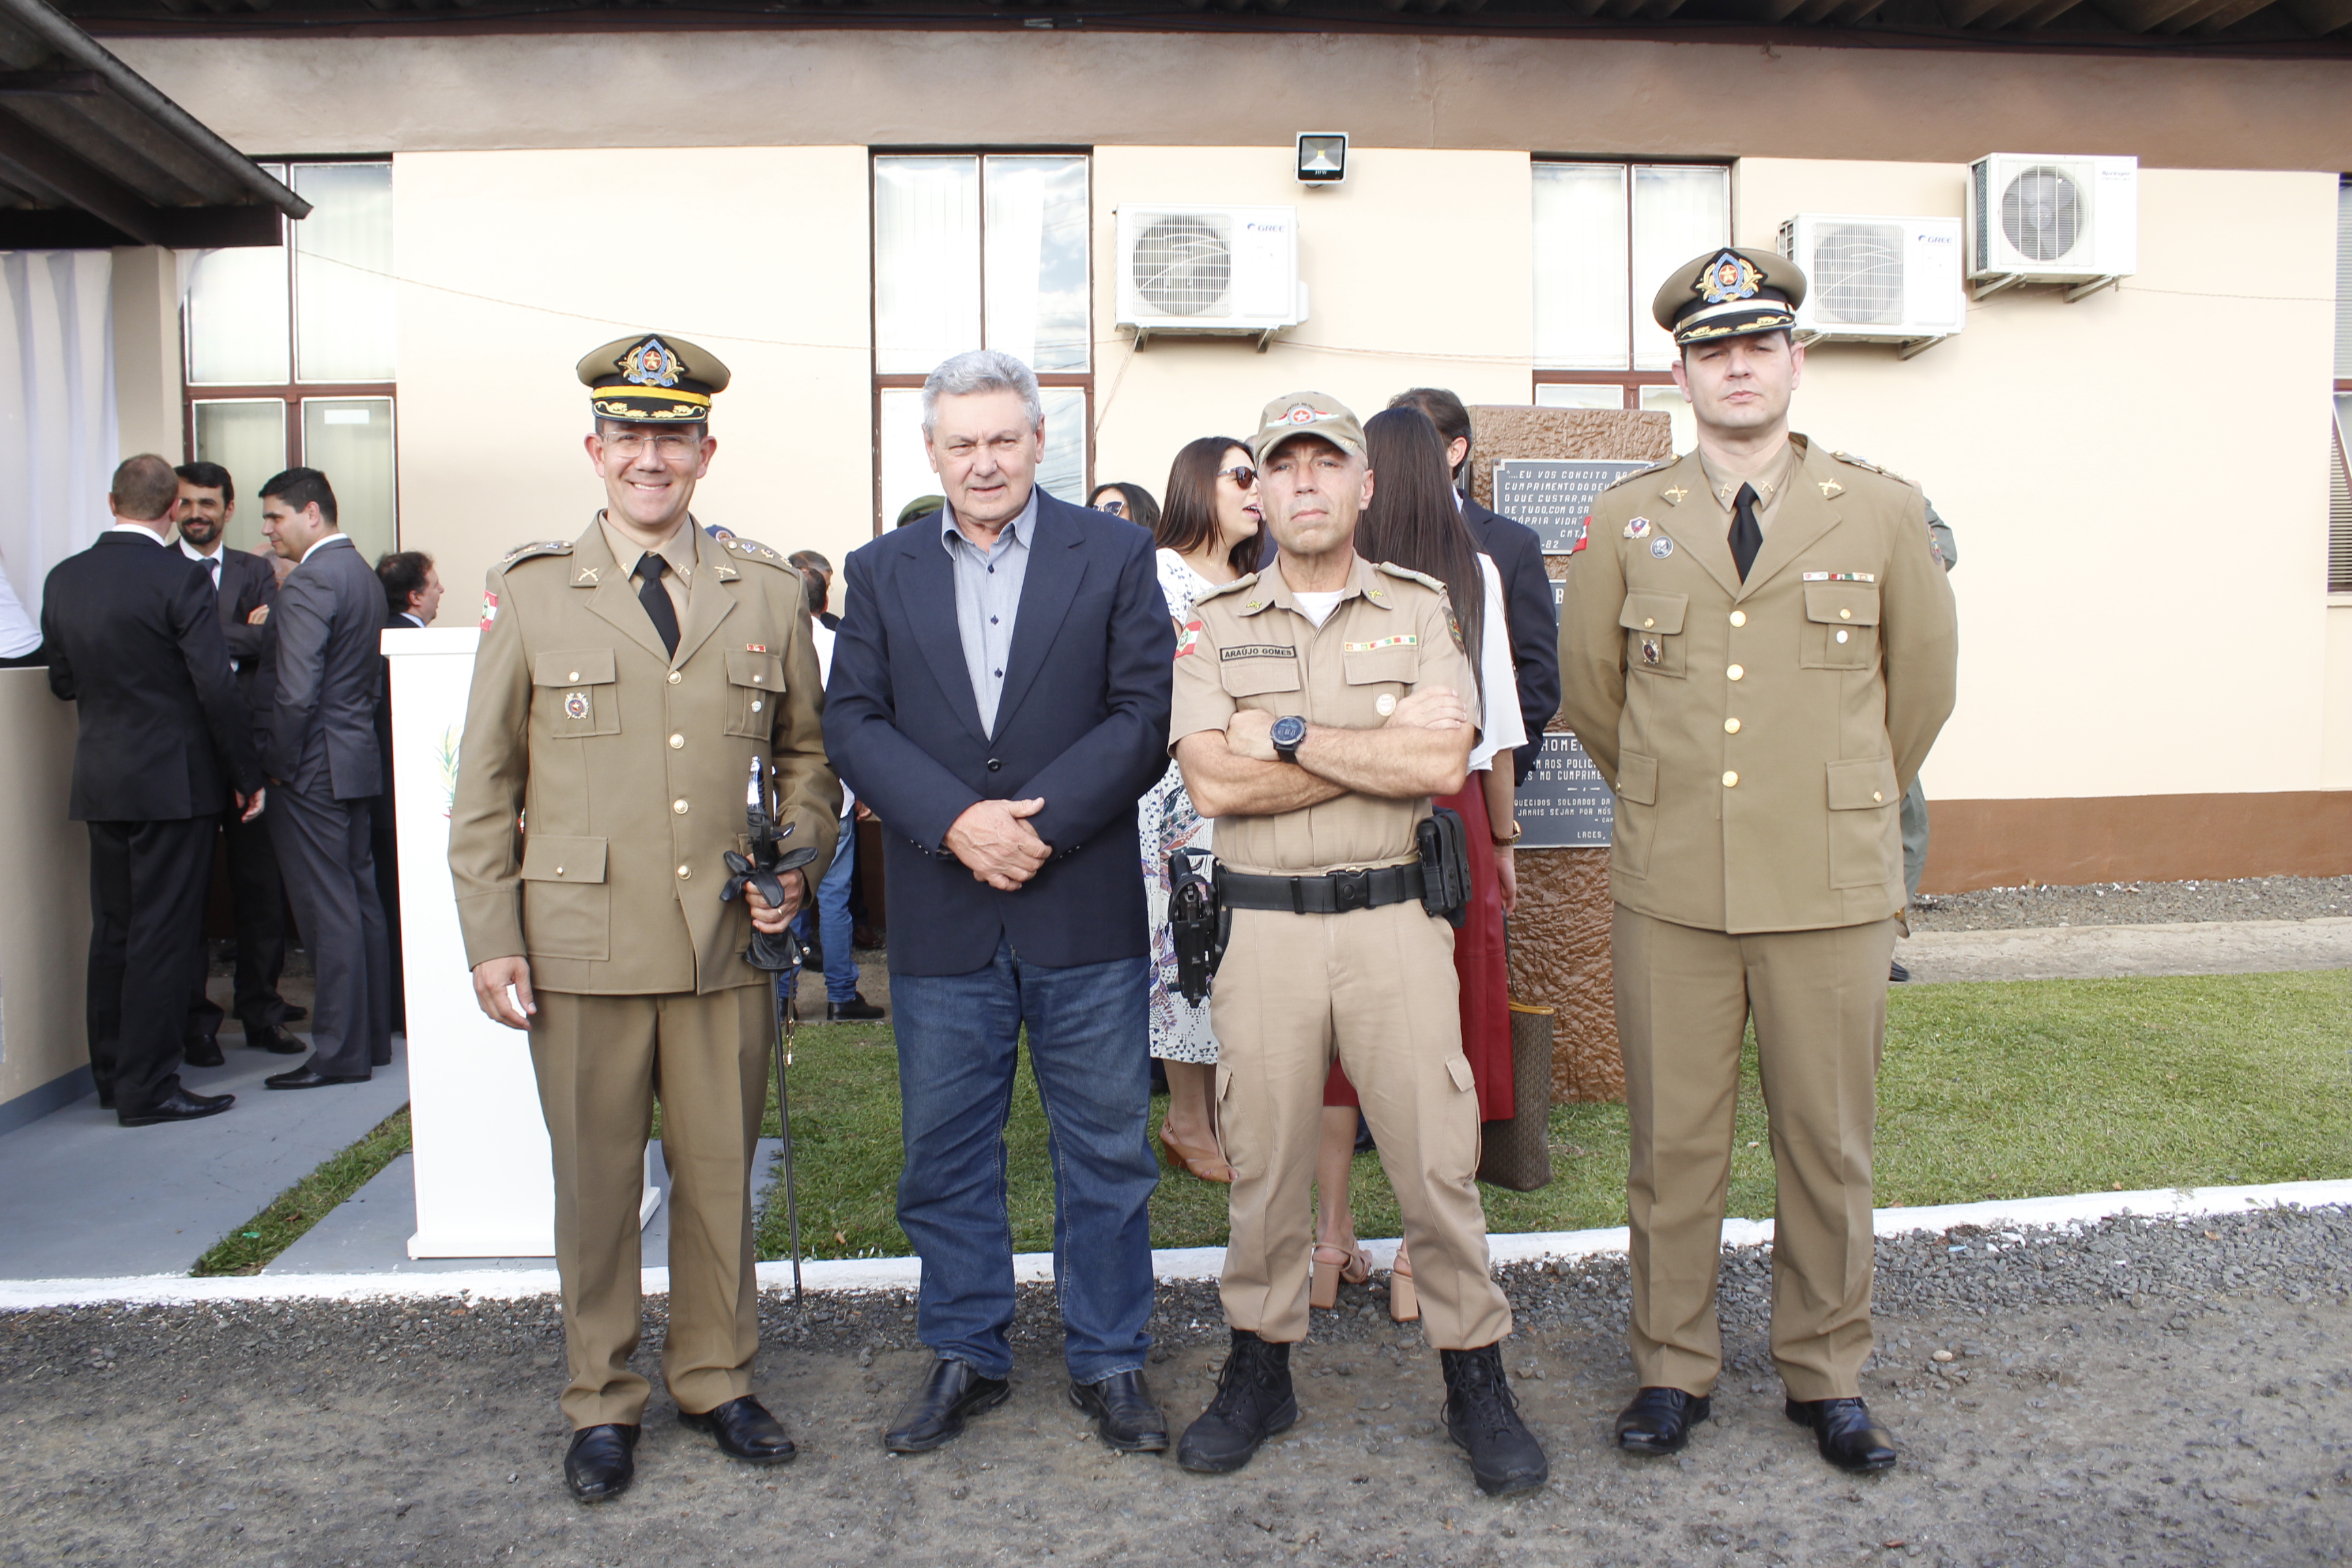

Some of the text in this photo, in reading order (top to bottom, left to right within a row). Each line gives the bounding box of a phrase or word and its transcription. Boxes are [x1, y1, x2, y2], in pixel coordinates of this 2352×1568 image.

[1538, 471, 1556, 479] VOS
[1562, 471, 1607, 479] CONCITO
[1505, 483, 1575, 491] CUMPRIMENTO
[1578, 483, 1589, 491] DO
[1504, 493, 1510, 502] O
[1514, 494, 1533, 503] QUE
[1504, 506, 1517, 514] DE
[1569, 506, 1575, 514] O
[1225, 647, 1292, 658] ARAÚJO GOMES
[1545, 759, 1562, 769] AOS
[1557, 770, 1605, 781] CUMPRIME
[1550, 808, 1574, 816] SEJAM
[1597, 806, 1611, 815] NÓS
